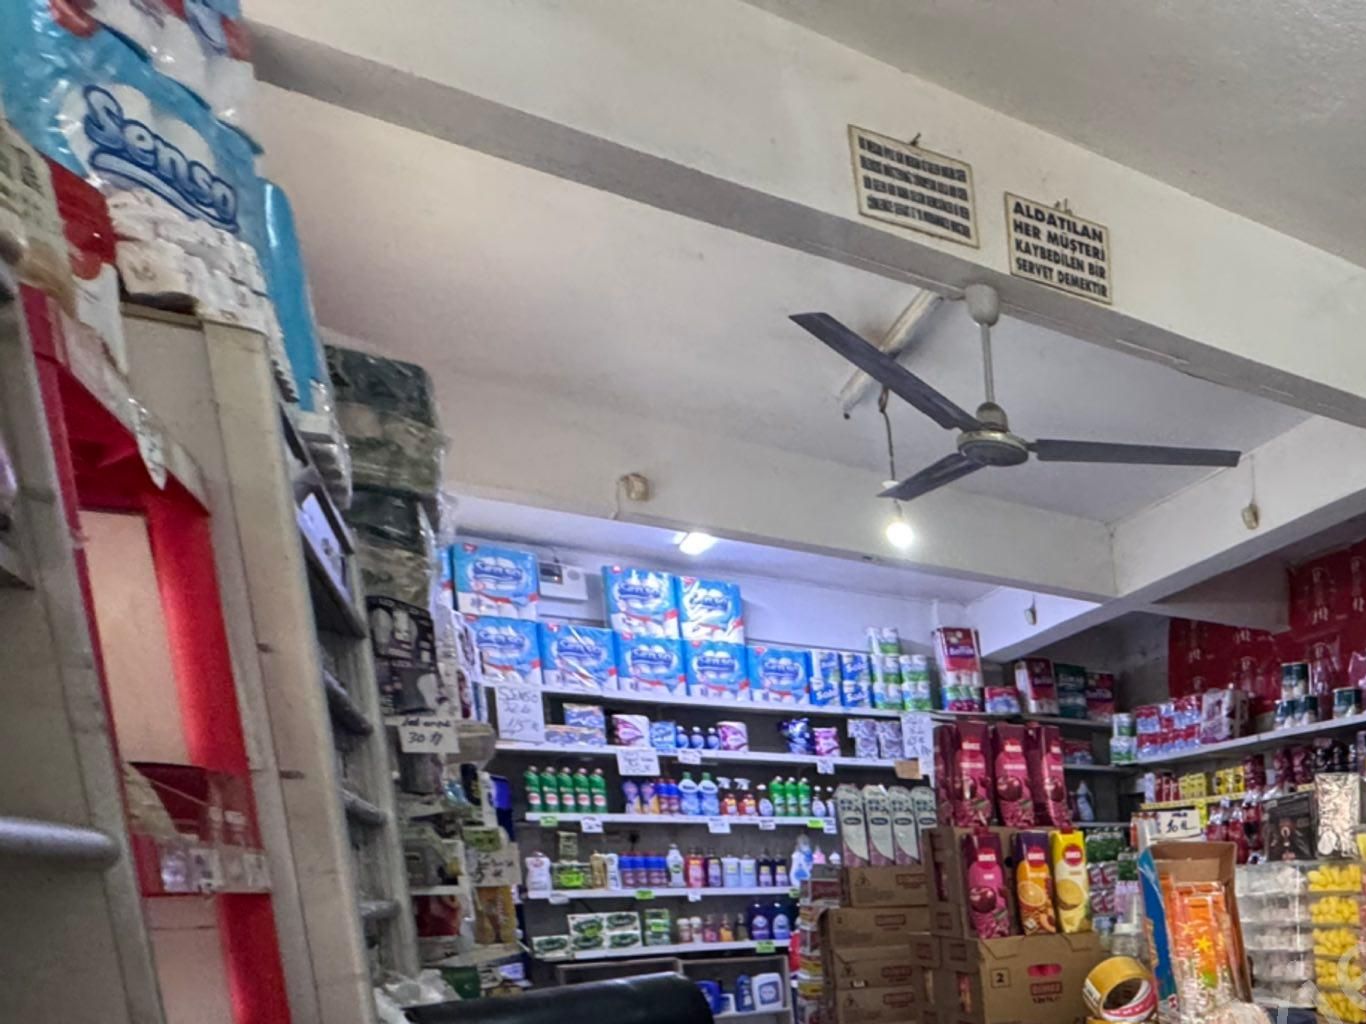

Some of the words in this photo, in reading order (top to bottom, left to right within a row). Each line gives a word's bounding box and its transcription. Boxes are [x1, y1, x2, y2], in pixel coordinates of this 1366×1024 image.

[1013, 201, 1103, 243] ALDATILAN
[1013, 219, 1041, 240] HER
[1047, 230, 1105, 262] MÜŞTERİ
[1015, 238, 1084, 272] KAYBEDİLEN
[1088, 261, 1106, 279] BİR
[1015, 257, 1054, 281] SERVET
